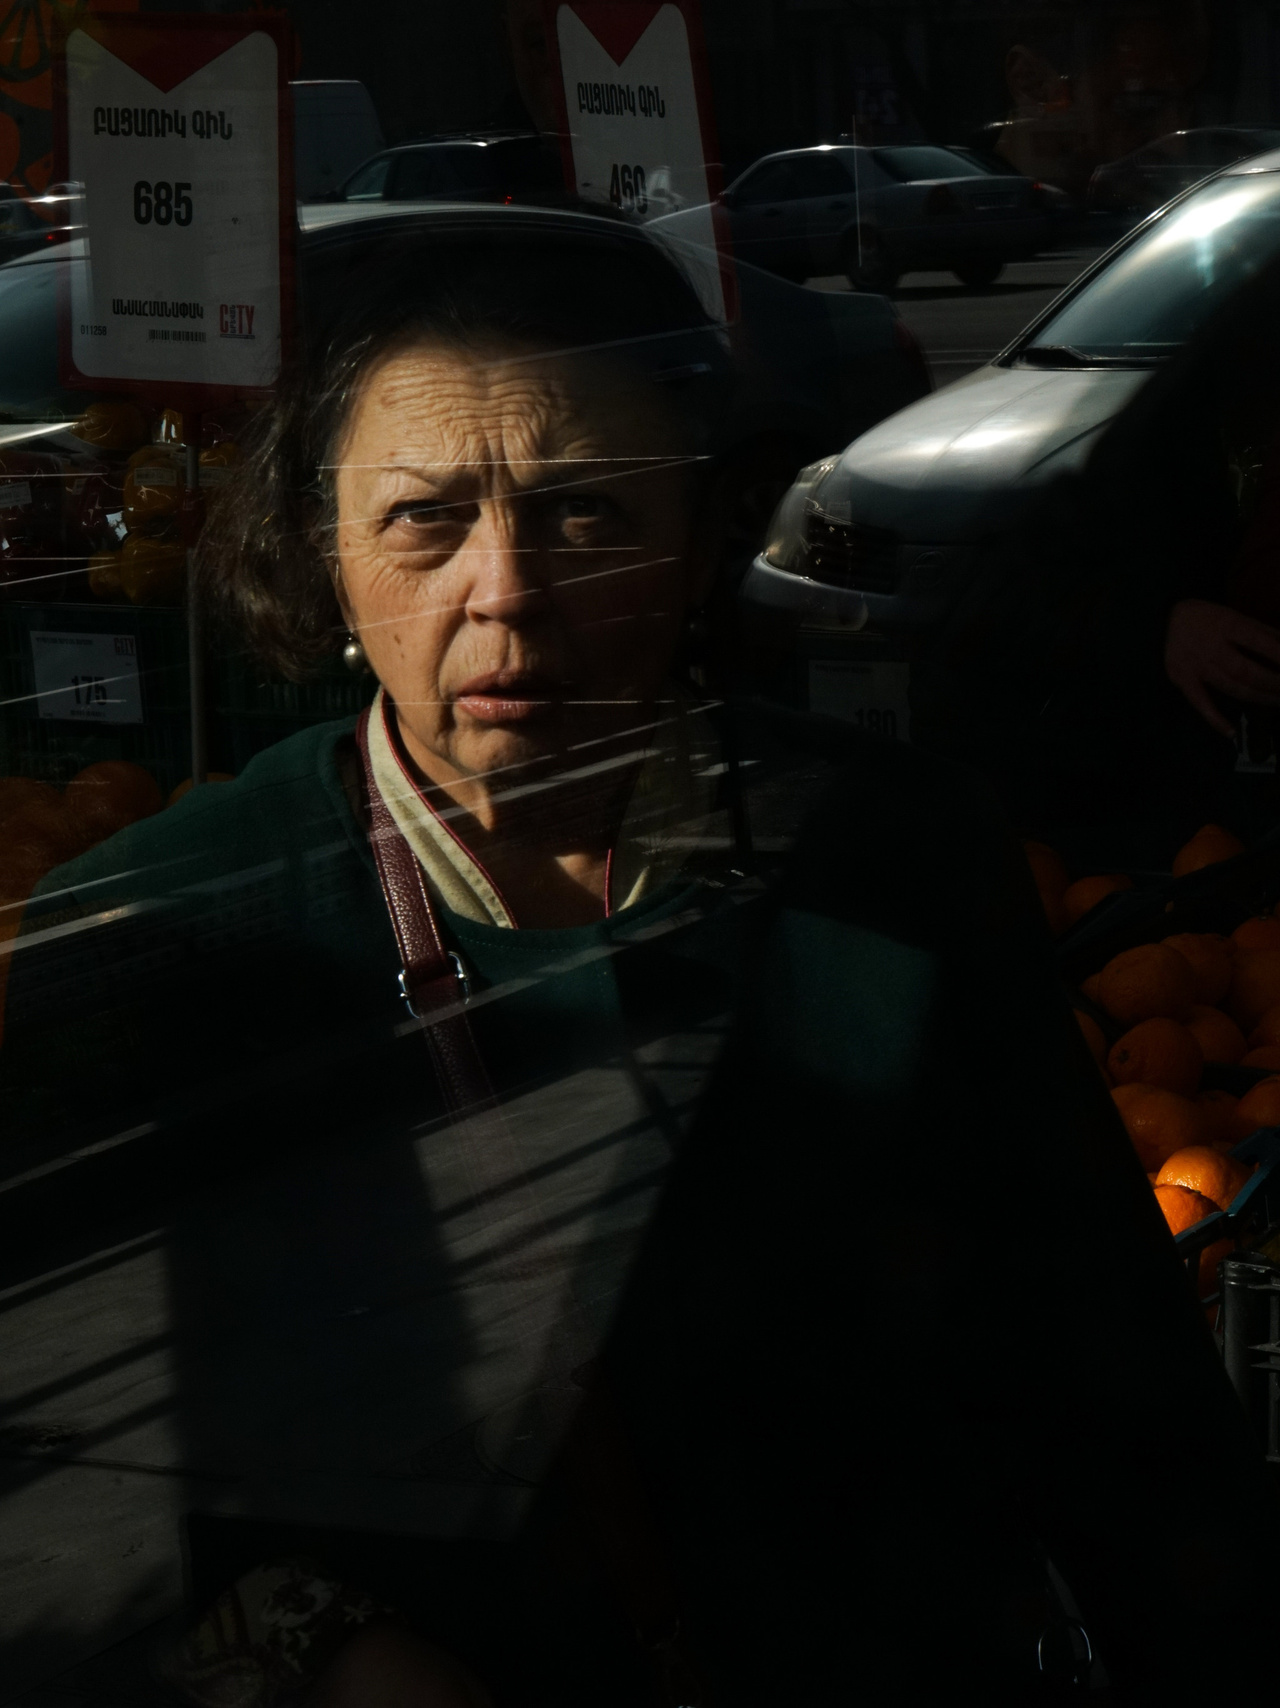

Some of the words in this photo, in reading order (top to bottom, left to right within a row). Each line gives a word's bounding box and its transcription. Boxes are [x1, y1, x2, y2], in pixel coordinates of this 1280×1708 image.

[577, 82, 636, 117] ԲԱՑԱՌԻԿ
[638, 85, 665, 118] ԳԻՆ
[93, 106, 186, 138] ԲԱՑԱՌԻԿ
[192, 110, 232, 140] ԳԻՆ
[133, 180, 193, 227] 685
[610, 163, 648, 214] 460
[112, 298, 204, 320] ԱՆՍԱՀՄԱՆԱՓԱԿ
[80, 324, 107, 336] 011258
[71, 675, 107, 705] 175
